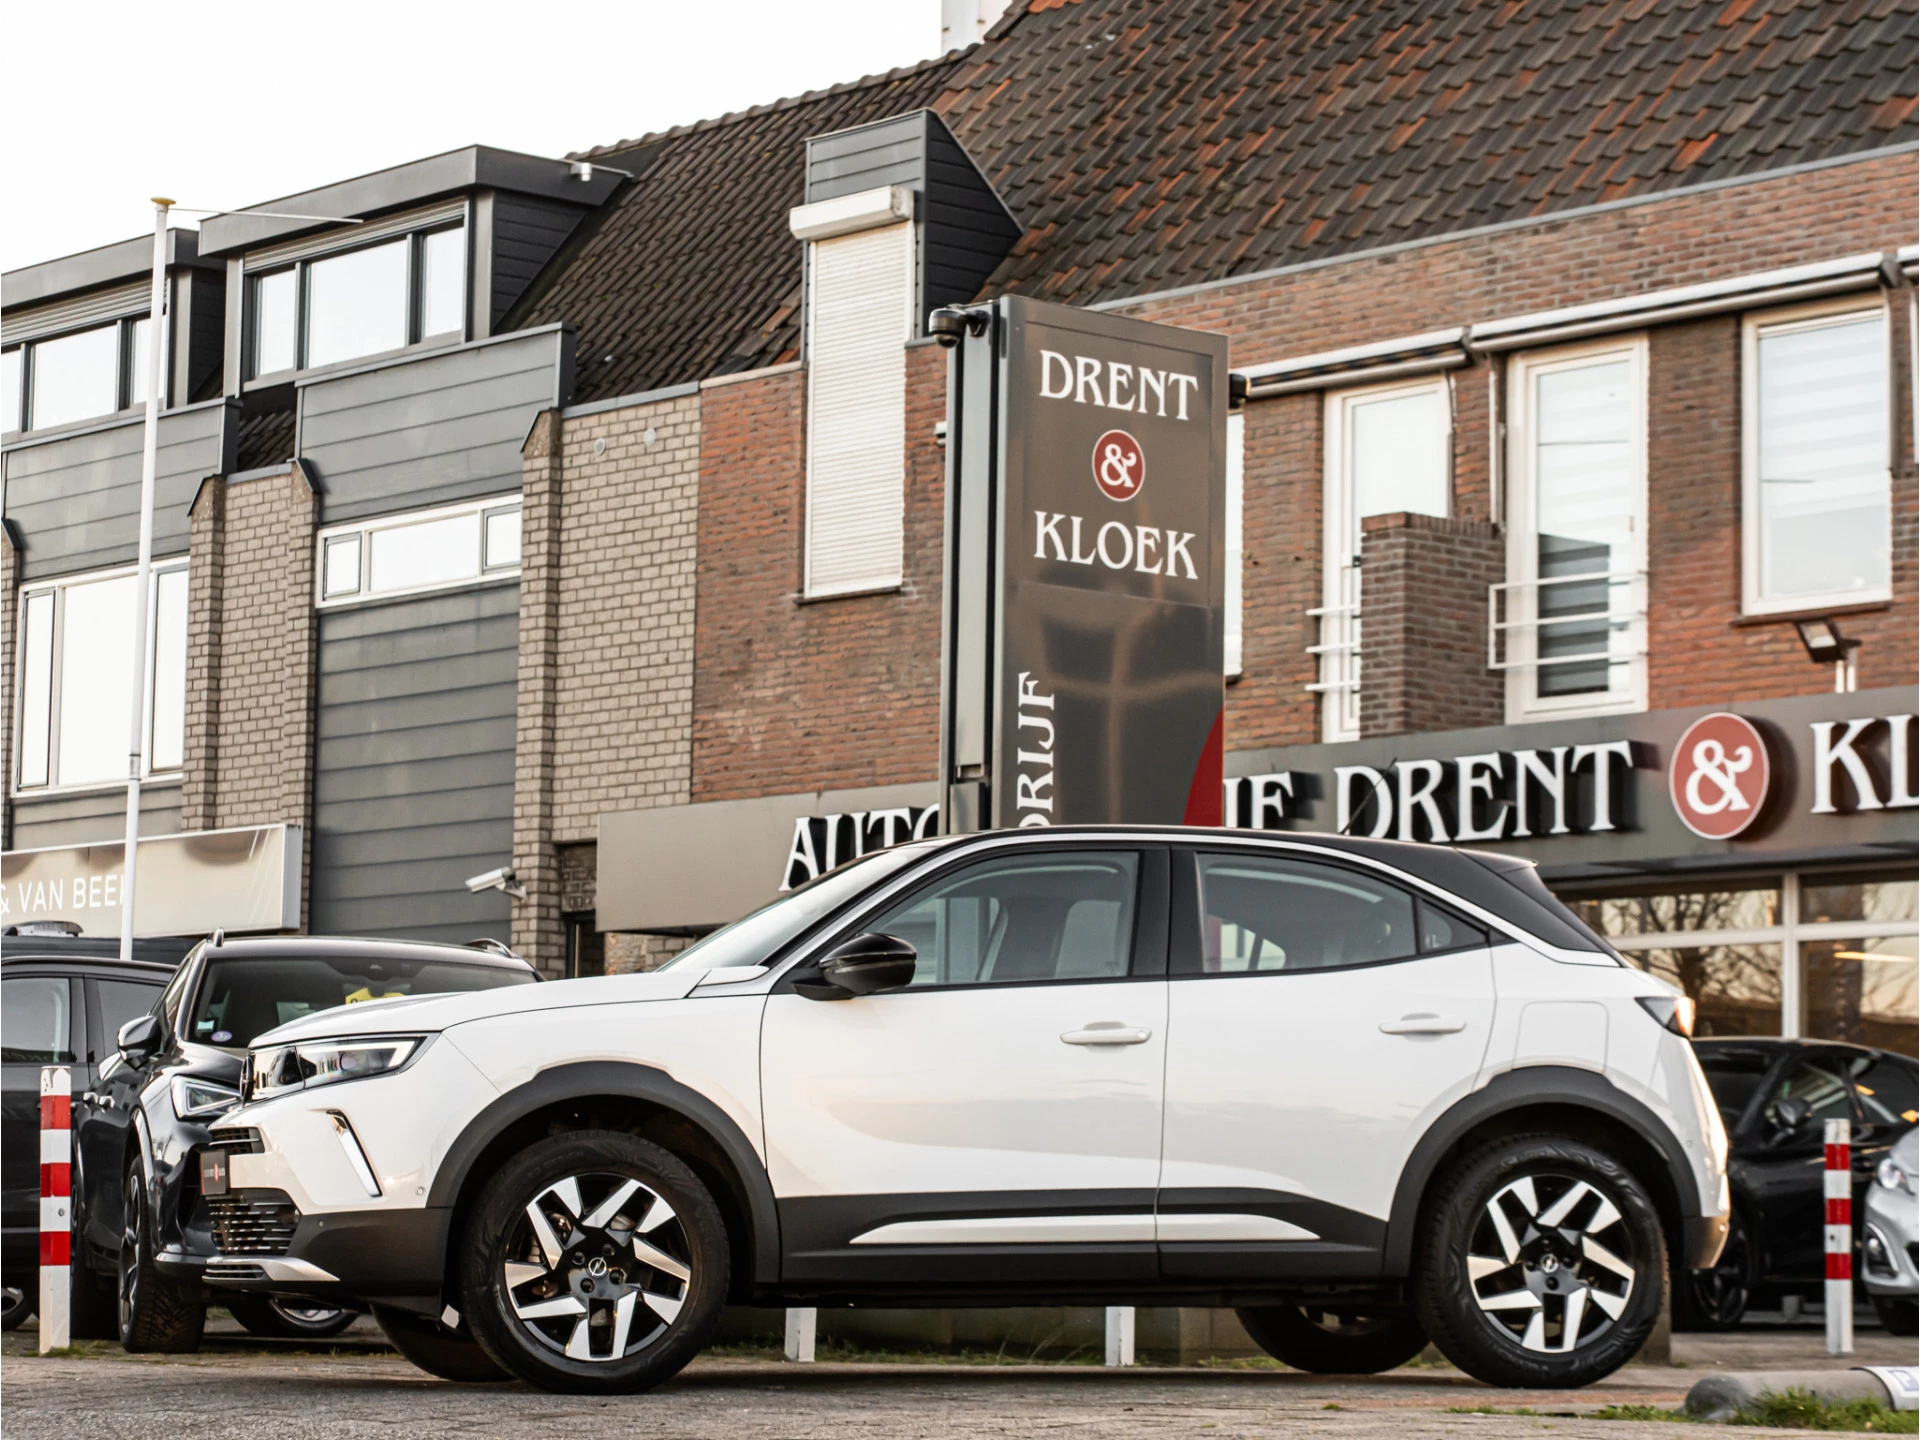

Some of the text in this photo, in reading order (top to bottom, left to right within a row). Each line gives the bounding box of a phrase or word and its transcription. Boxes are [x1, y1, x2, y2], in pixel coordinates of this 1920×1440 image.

[1039, 349, 1199, 421] DRENT
[1100, 443, 1137, 488] &
[1033, 510, 1199, 580] KLOEK
[1333, 740, 1633, 843] DRENT
[1685, 739, 1753, 815] &
[18, 878, 64, 913] VAN
[72, 873, 124, 909] BEE
